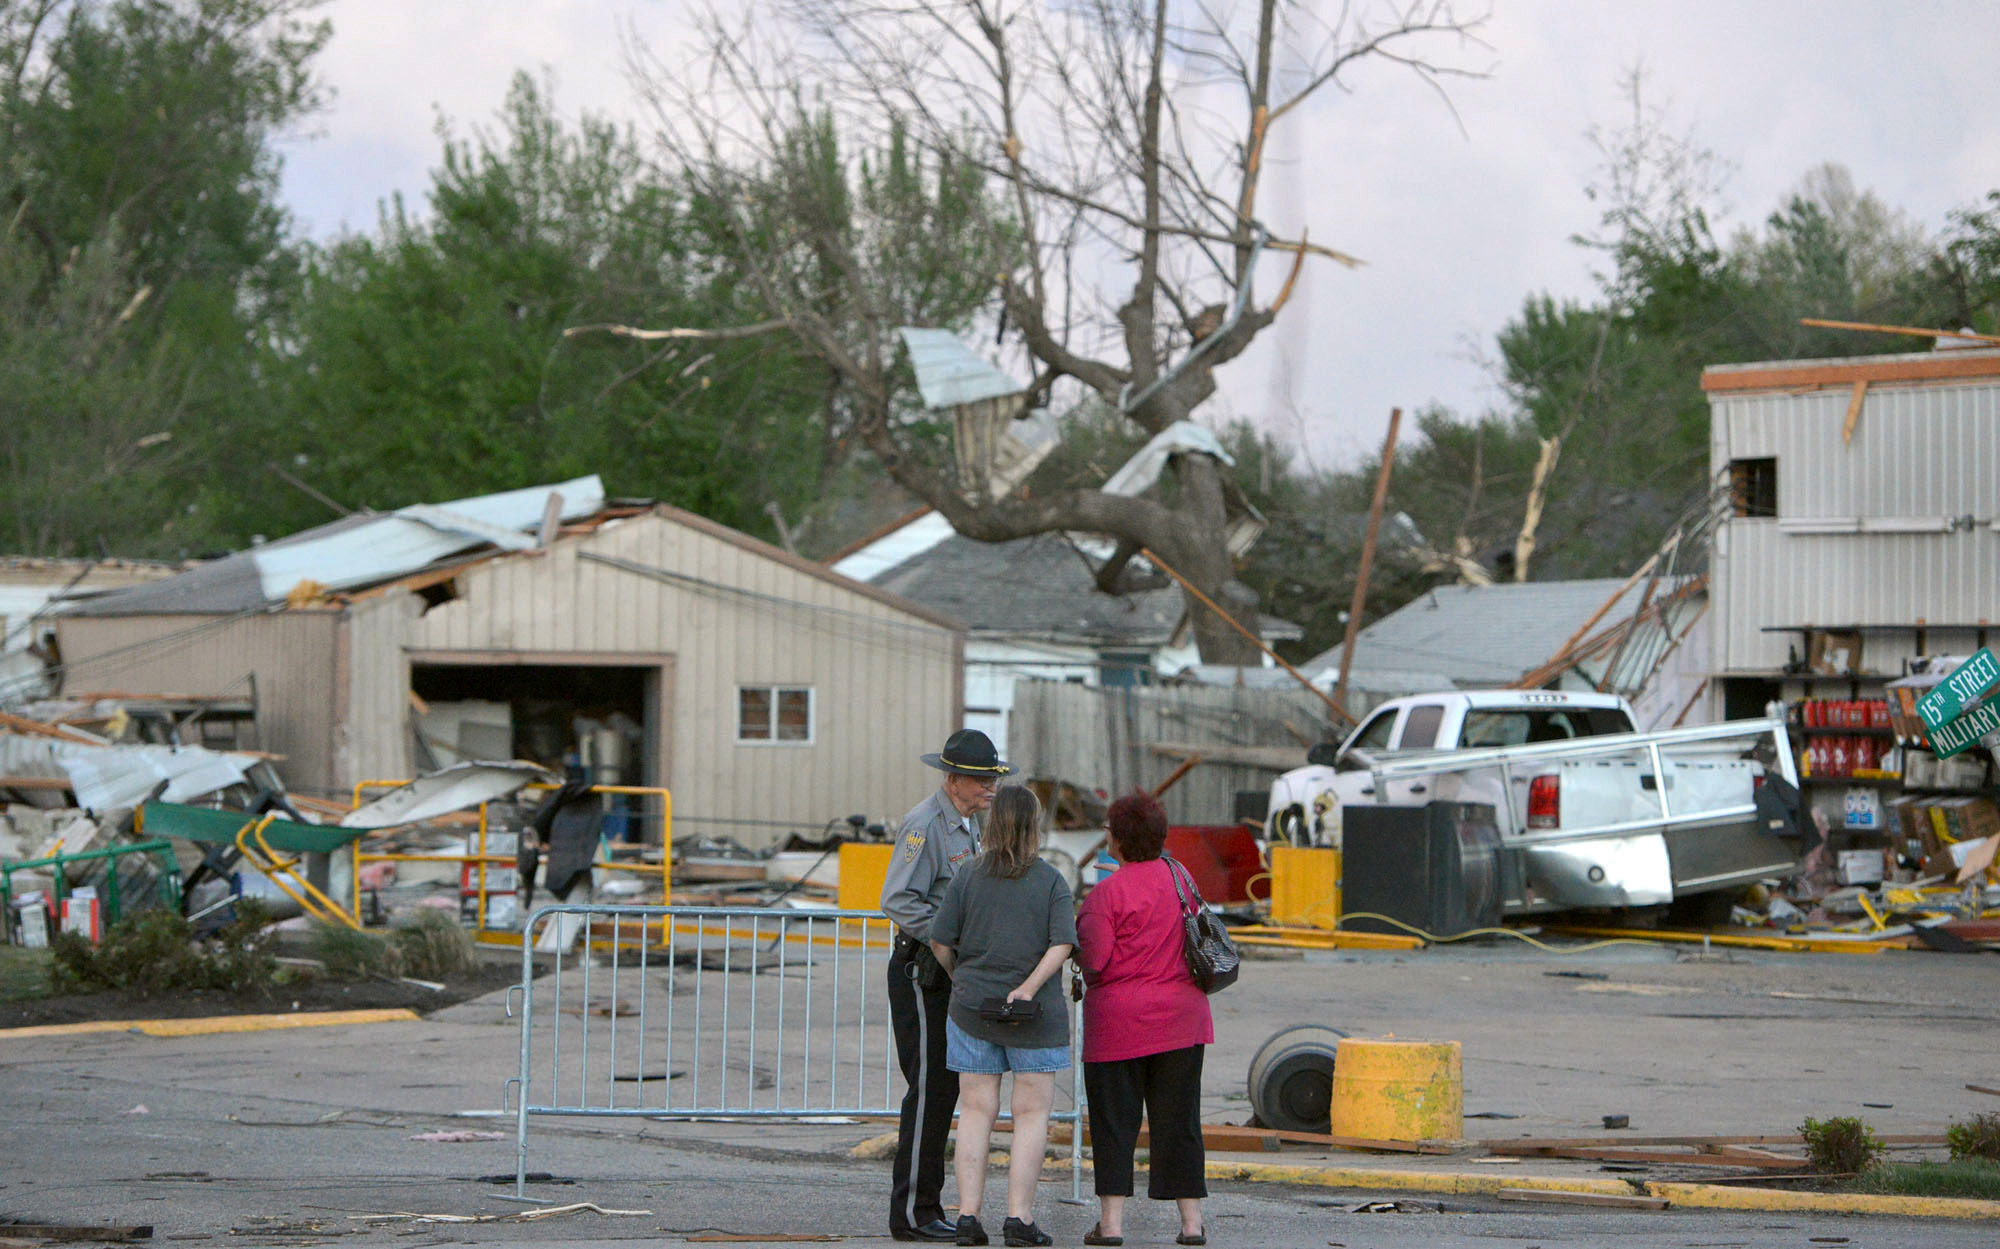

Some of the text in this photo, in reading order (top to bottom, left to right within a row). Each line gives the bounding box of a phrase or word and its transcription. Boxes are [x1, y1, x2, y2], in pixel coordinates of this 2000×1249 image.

[1921, 653, 1997, 726] 15TH STREET
[1931, 702, 2000, 754] MILITARY
